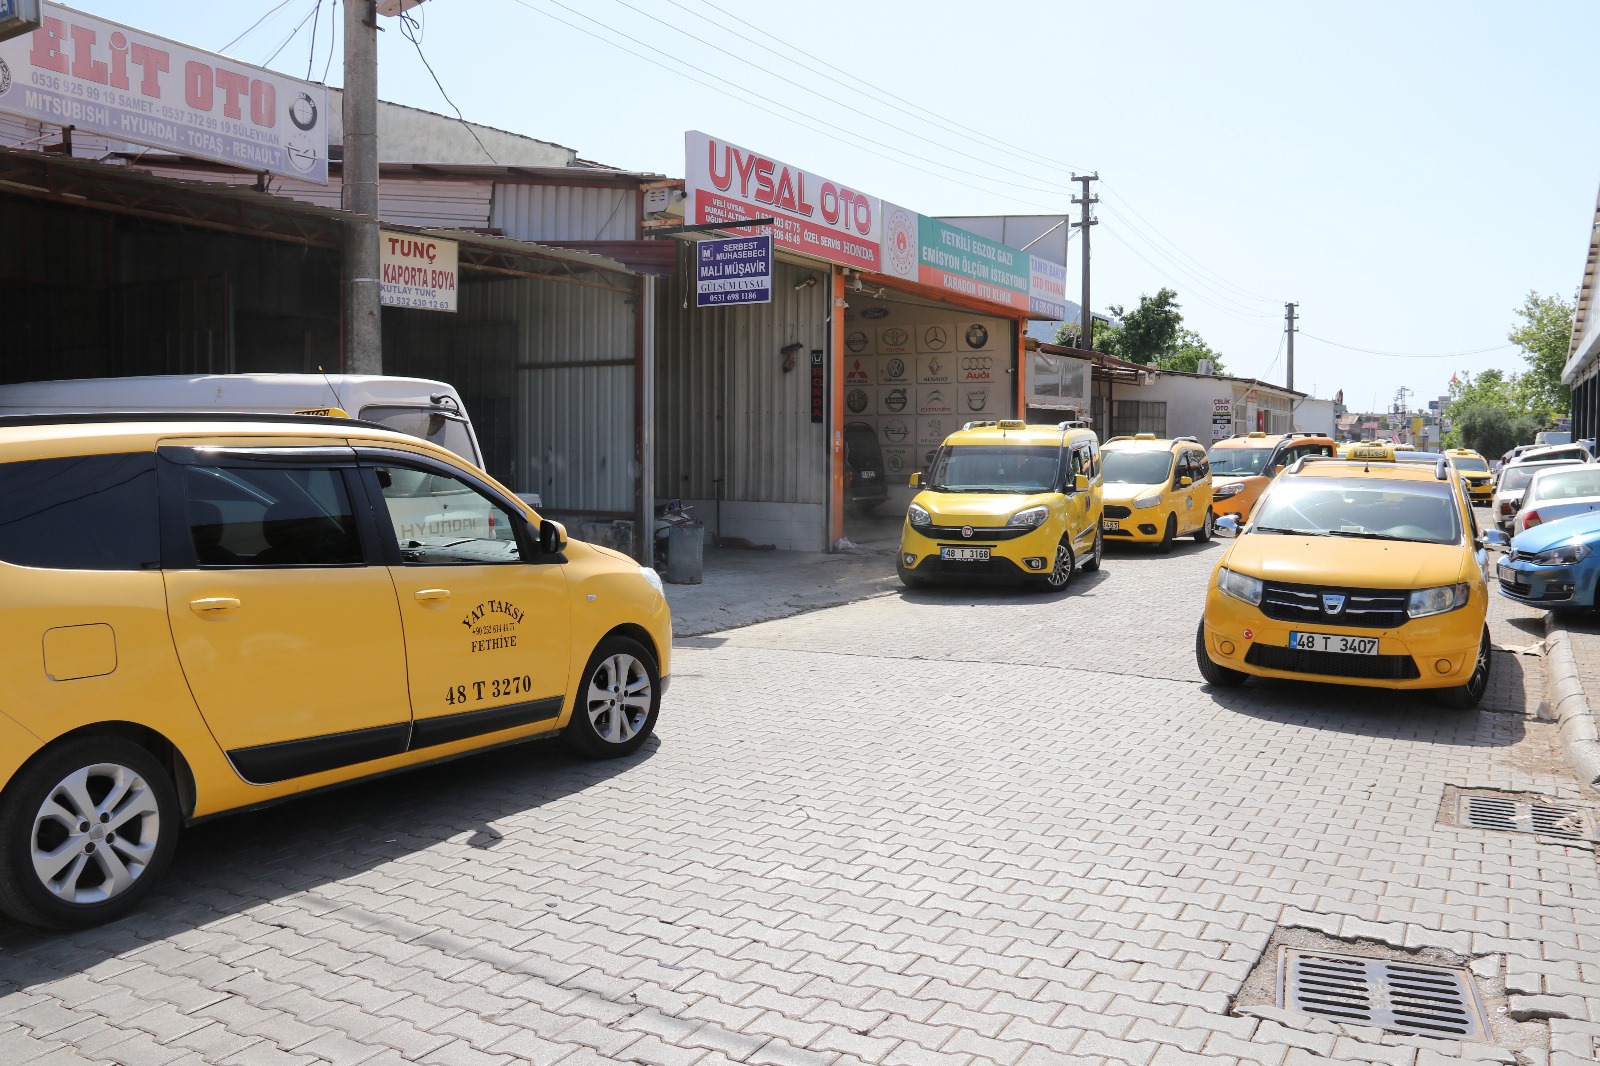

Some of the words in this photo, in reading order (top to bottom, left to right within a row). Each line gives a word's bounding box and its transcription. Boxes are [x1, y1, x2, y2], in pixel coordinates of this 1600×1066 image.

[184, 60, 276, 128] OTO
[31, 71, 60, 90] 0536
[63, 80, 84, 97] 925
[86, 86, 100, 101] 99
[103, 90, 116, 105] 19
[118, 94, 154, 113] SAMET
[162, 105, 185, 121] 0537
[187, 112, 204, 126] 372
[206, 117, 218, 130] 99
[220, 120, 231, 133] 19
[232, 122, 280, 145] SÜLEYMAN
[25, 90, 110, 127] MITSUBISHI
[121, 114, 177, 143] HYUNDAI
[187, 130, 224, 157] TOFAŞ
[232, 141, 281, 166] RENAULT
[708, 139, 814, 217] UYSAL
[820, 181, 871, 235] OTO
[726, 202, 746, 214] UYSAL
[388, 237, 437, 264] TUNÇ
[723, 241, 758, 252] SERBEST
[803, 228, 820, 245] ÖZEL
[842, 240, 875, 262] HONDA
[972, 240, 996, 260] EGZOZ
[997, 249, 1013, 266] GAZI
[383, 263, 428, 288] KAPORTA
[431, 269, 455, 291] BOYA
[700, 262, 723, 278] MALİ
[724, 260, 766, 277] MÜŞAVİR
[962, 255, 989, 279] ÖLÇÜM
[380, 283, 412, 295] KUTLAY
[414, 287, 437, 299] TUNÇ
[700, 280, 736, 292] GÜLSÜM
[738, 279, 766, 290] UYSAL
[977, 283, 991, 299] OTO
[389, 296, 394, 304] 0
[396, 296, 410, 305] 532
[412, 298, 427, 307] 430
[429, 300, 438, 309] 12
[439, 301, 449, 309] 63
[709, 294, 725, 302] 0531
[726, 292, 740, 301] 698
[741, 291, 757, 300] 1186
[966, 370, 990, 380] Audi
[400, 517, 476, 539] HYUNDAI
[946, 549, 956, 558] 48
[960, 549, 965, 558] T
[969, 549, 989, 559] 3168
[462, 603, 485, 629] YAT
[471, 634, 517, 653] FETHİYE
[1297, 634, 1315, 649] 48
[1322, 636, 1331, 651] T
[1339, 637, 1377, 654] 3407
[445, 684, 467, 706] 48
[472, 680, 486, 701] T
[491, 674, 532, 698] 3270
